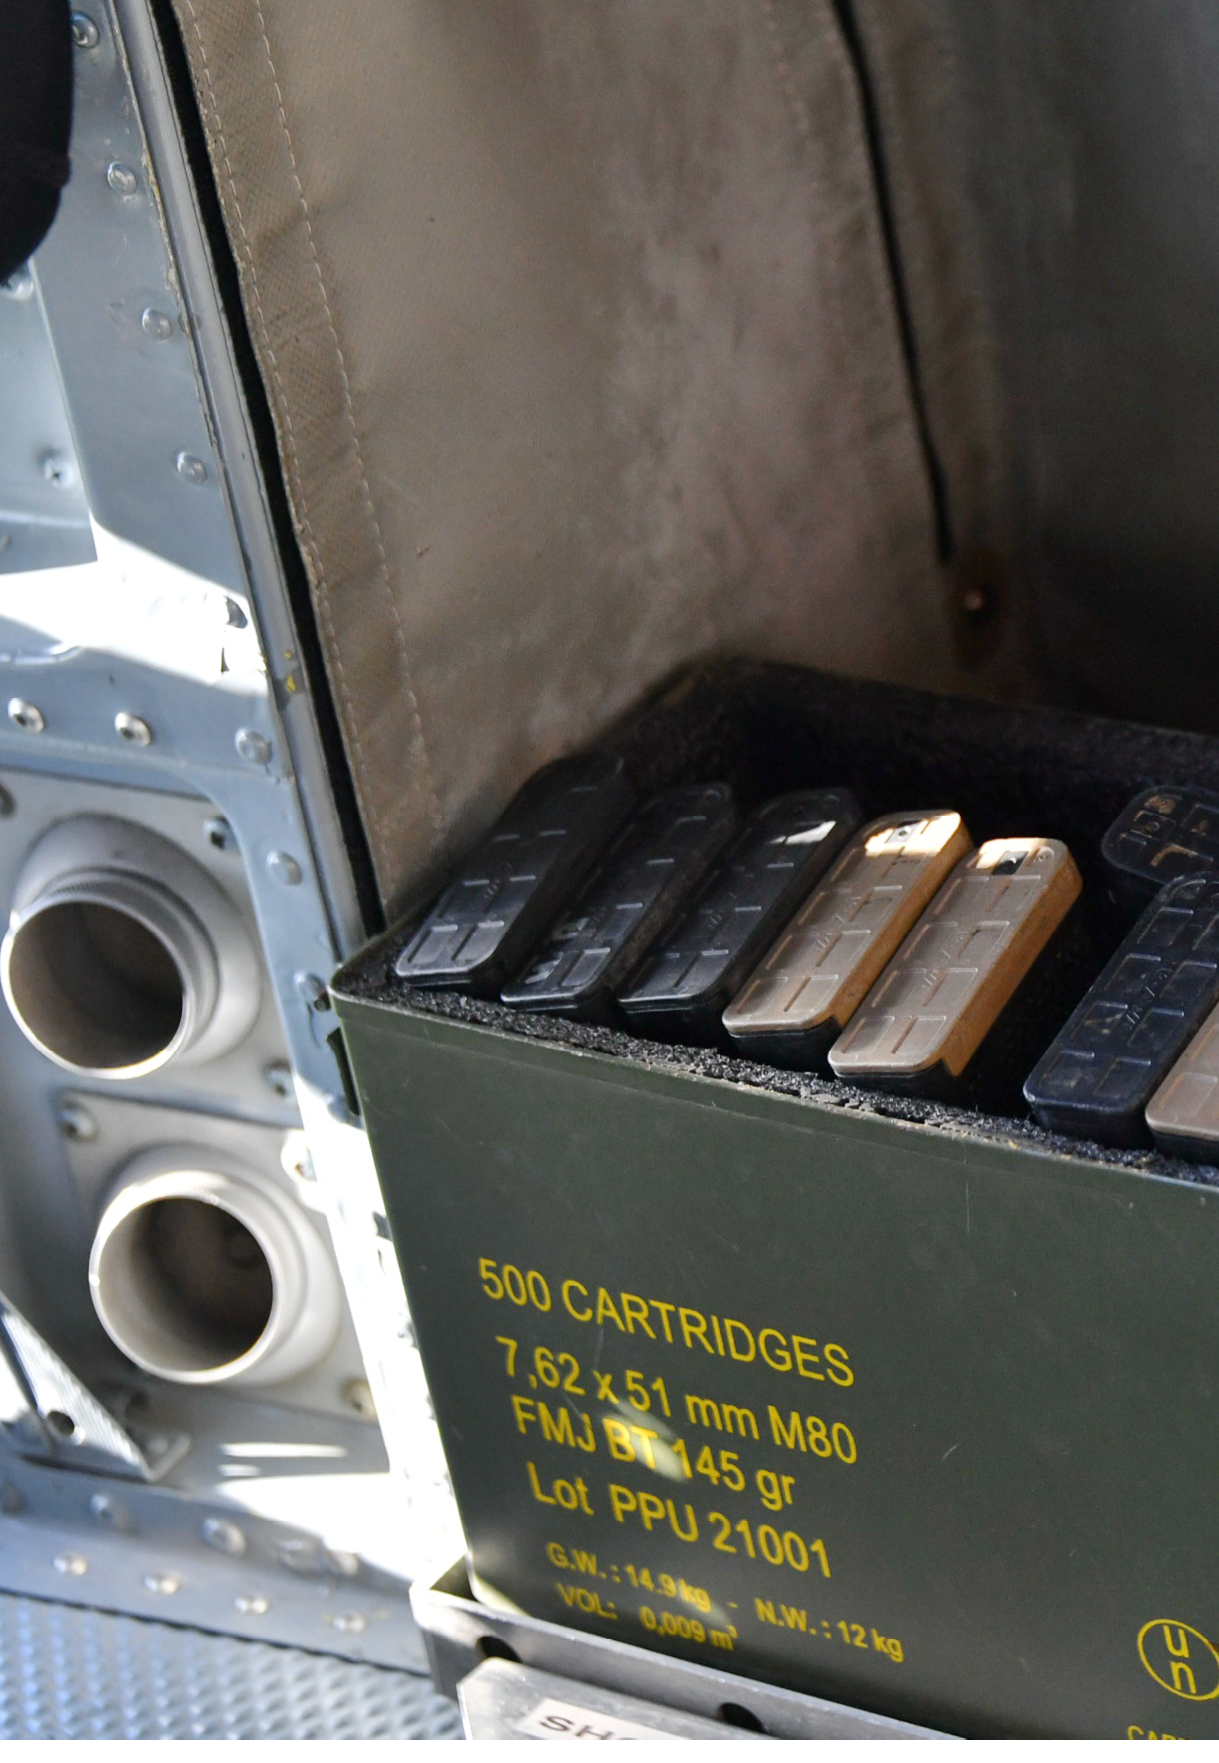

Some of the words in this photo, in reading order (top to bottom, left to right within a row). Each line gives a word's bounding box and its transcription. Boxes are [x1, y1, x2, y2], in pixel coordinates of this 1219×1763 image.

[479, 1257, 553, 1313] 500
[561, 1278, 856, 1388] CARTRIDGES
[496, 1335, 587, 1396] 7,62
[592, 1370, 621, 1405] x
[625, 1369, 672, 1418] 51
[684, 1394, 761, 1441] mm
[767, 1405, 858, 1465] M80
[511, 1394, 597, 1453] FMJ
[602, 1416, 657, 1470] BT
[671, 1437, 746, 1492] 145
[755, 1468, 796, 1512] gr
[527, 1461, 594, 1516] Lot
[608, 1483, 700, 1543] PPU
[707, 1511, 832, 1578] 21001
[539, 1714, 642, 1740] SH
